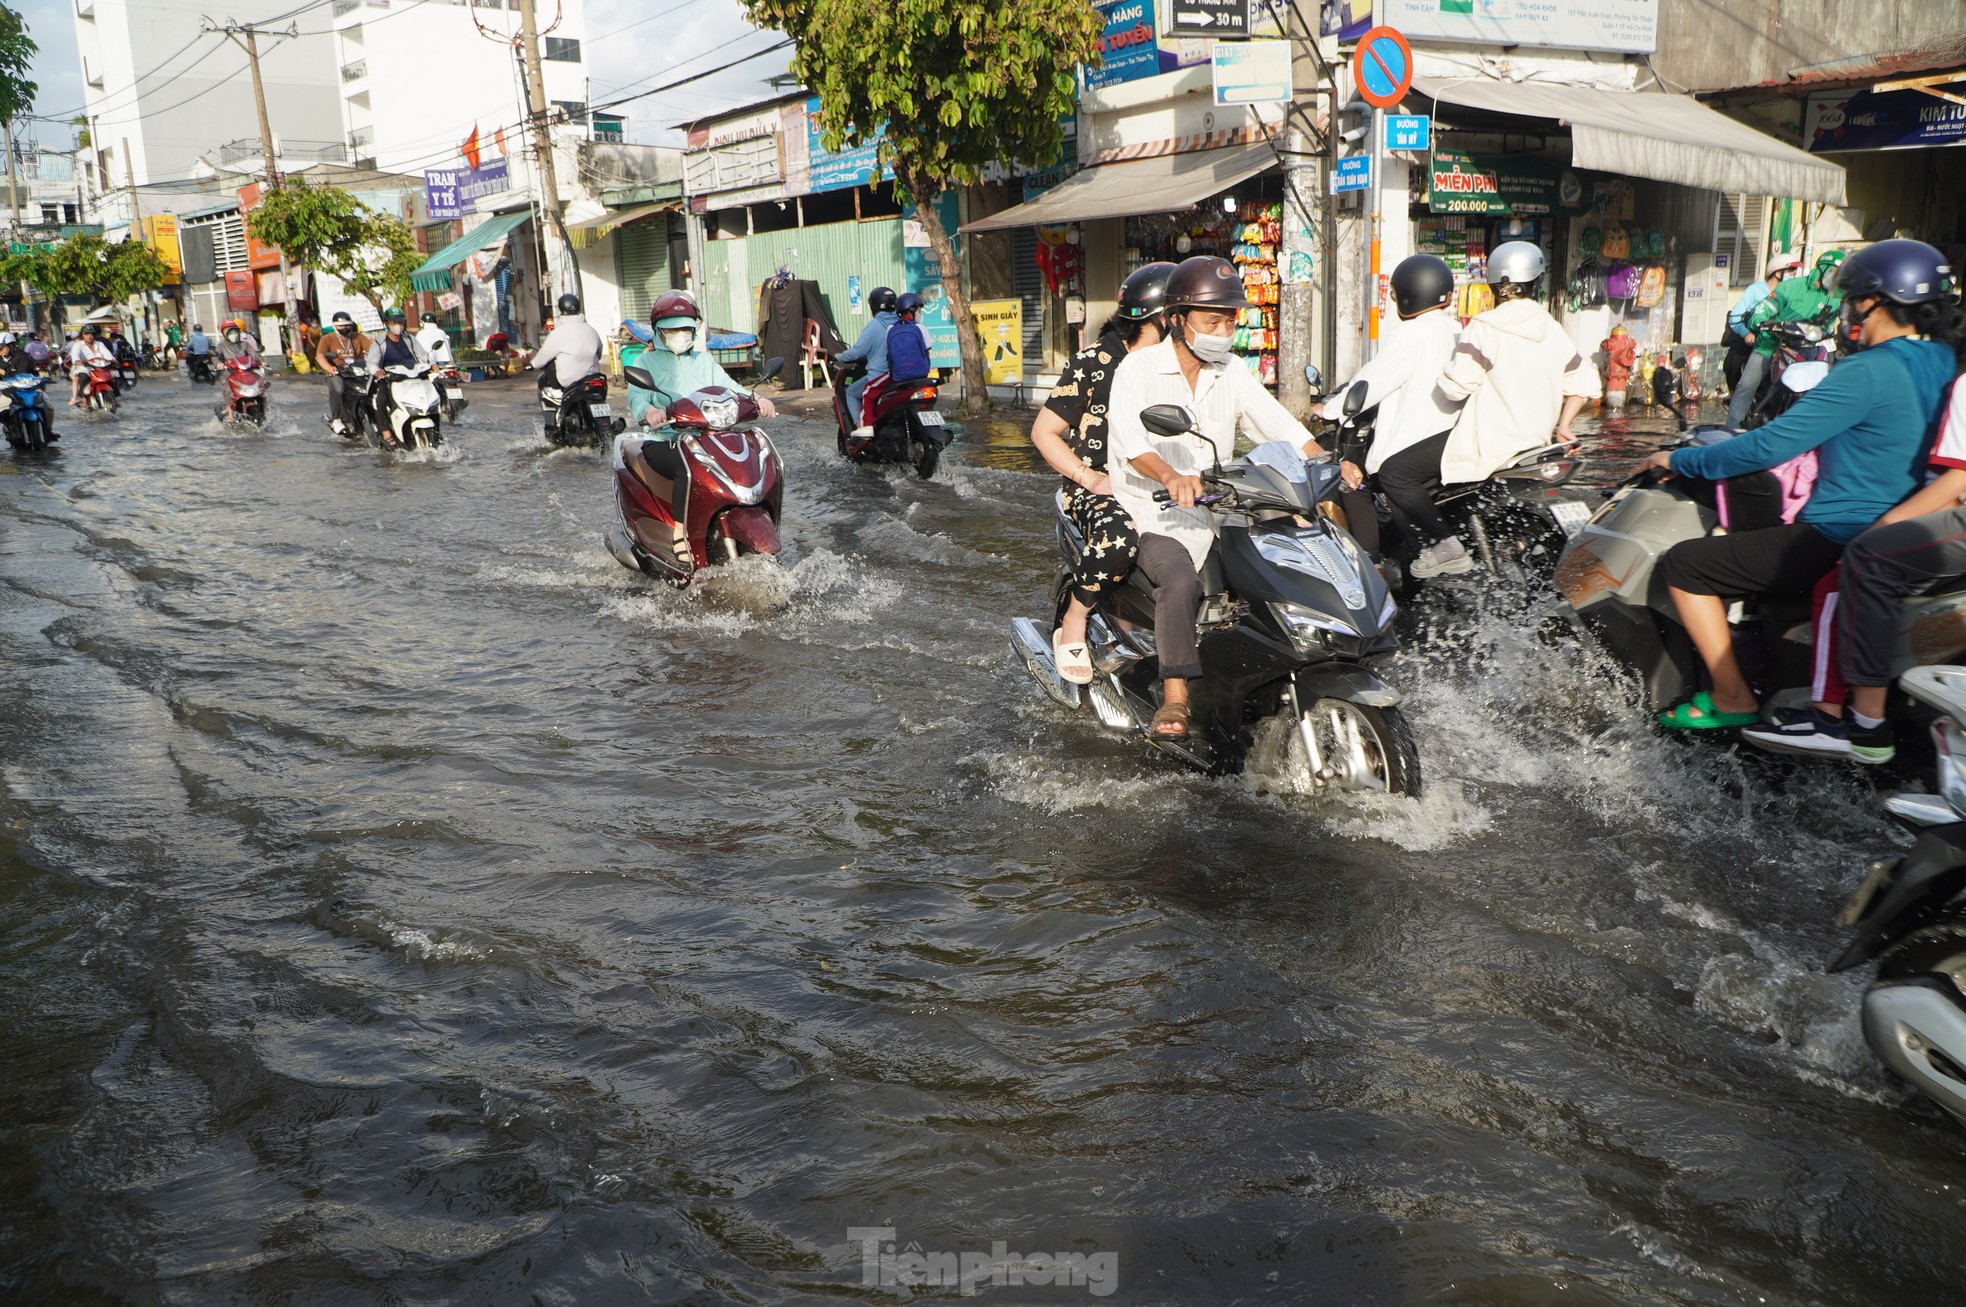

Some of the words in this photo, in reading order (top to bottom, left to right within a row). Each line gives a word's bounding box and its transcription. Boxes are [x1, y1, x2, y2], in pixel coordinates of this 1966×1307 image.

[1112, 5, 1142, 24] HÀNG
[1216, 12, 1230, 26] 30
[1231, 15, 1243, 26] m
[1919, 106, 1947, 122] KIM
[1396, 118, 1419, 129] ĐƯỜNG
[1342, 160, 1361, 171] ĐƯỜNG
[427, 172, 457, 189] TRẠM
[1029, 174, 1059, 188] CLEAN
[1434, 164, 1473, 192] MIỄN
[431, 192, 440, 206] Y
[441, 186, 456, 206] TẾ
[1448, 200, 1488, 212] 200.000
[981, 313, 999, 321] SINH
[1000, 310, 1018, 320] GIÀY
